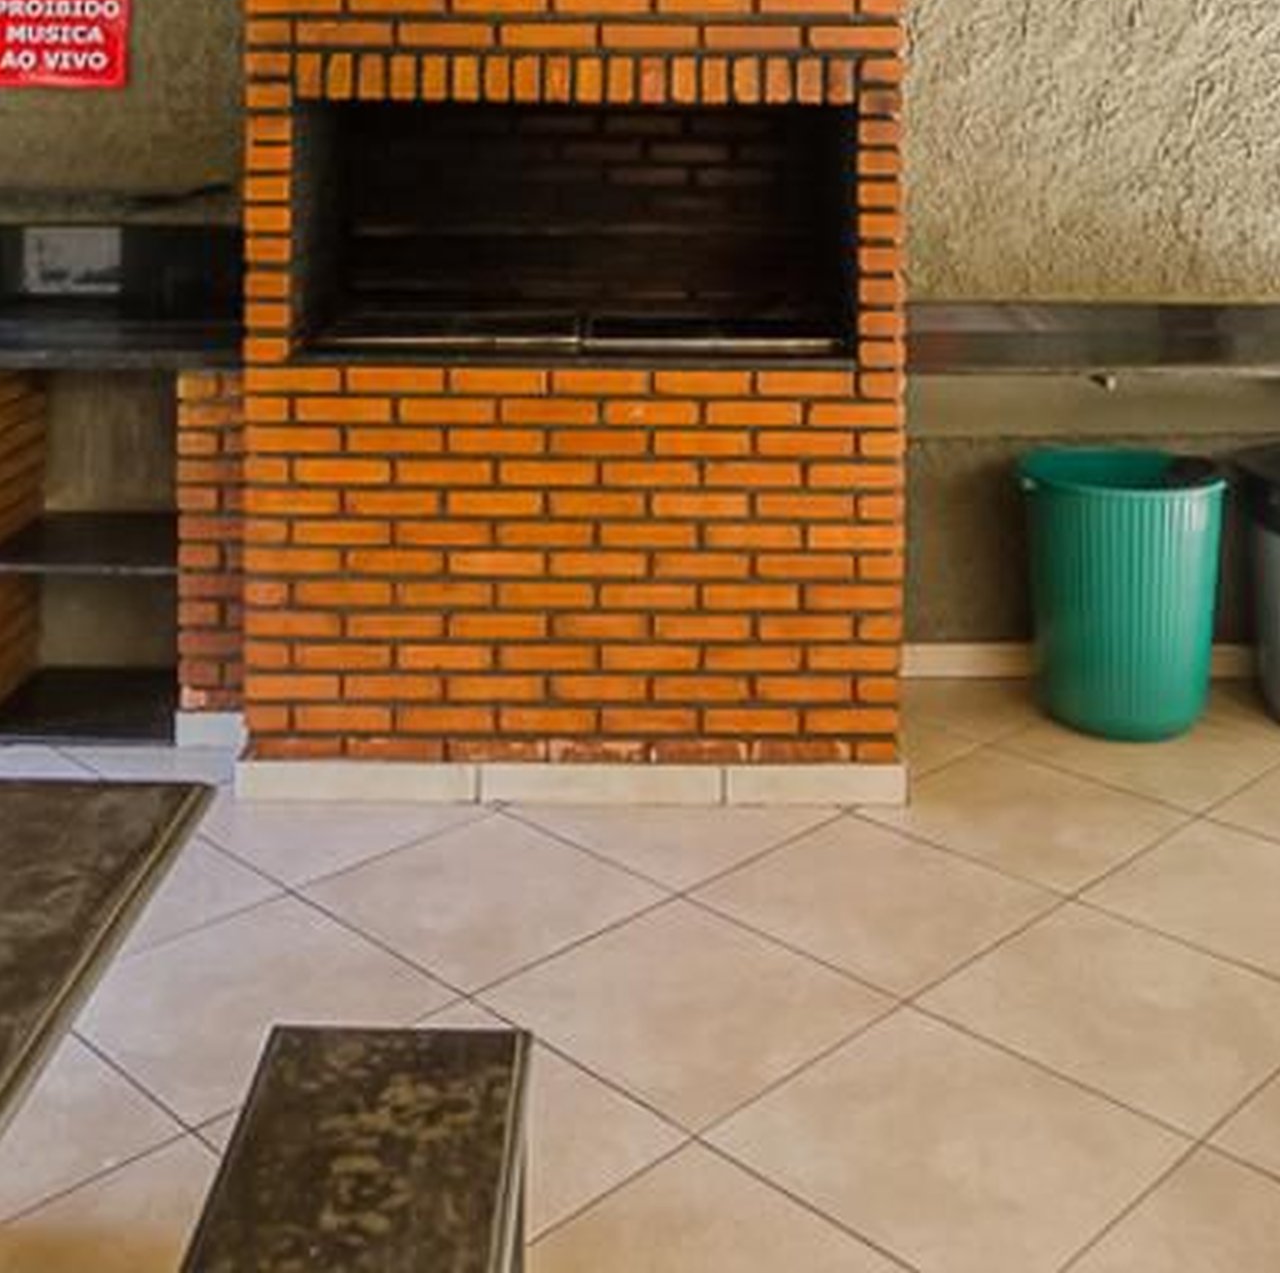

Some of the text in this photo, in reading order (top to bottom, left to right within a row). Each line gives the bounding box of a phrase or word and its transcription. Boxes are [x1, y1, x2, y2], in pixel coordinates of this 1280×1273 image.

[5, 25, 105, 44] MUSICA
[0, 49, 109, 72] AO VIVO
